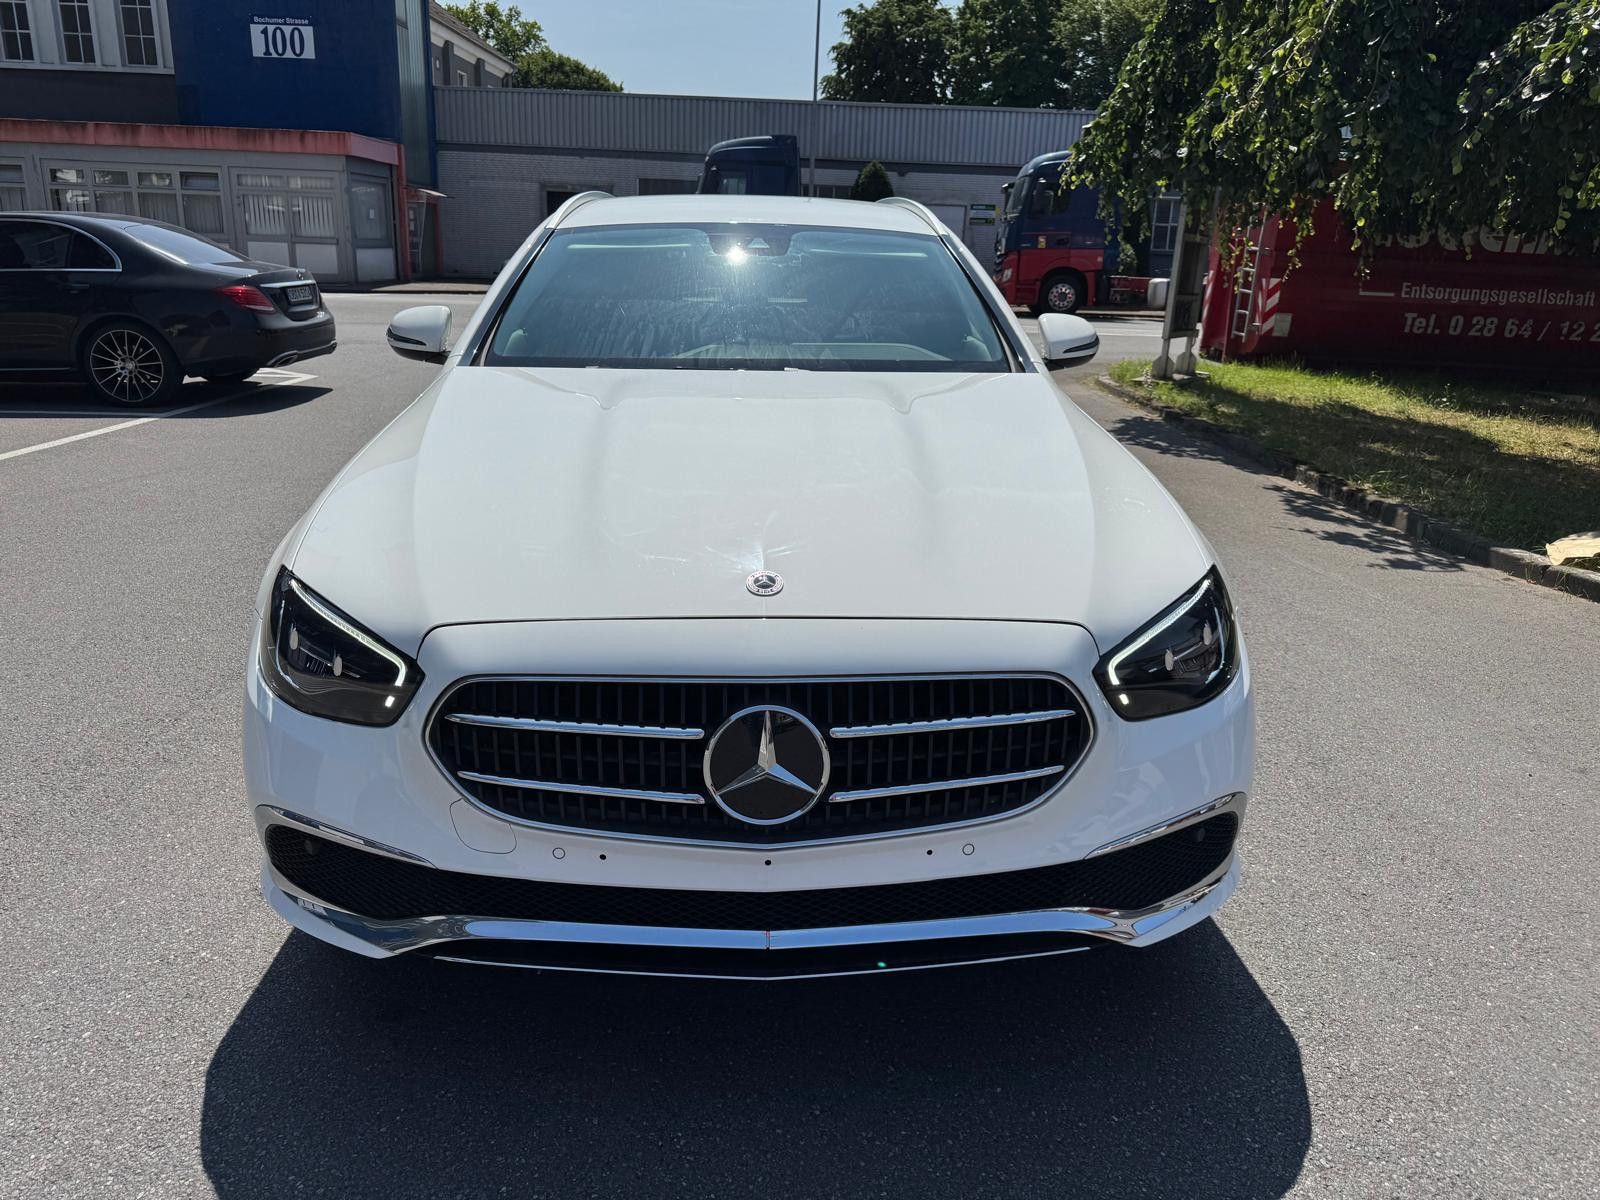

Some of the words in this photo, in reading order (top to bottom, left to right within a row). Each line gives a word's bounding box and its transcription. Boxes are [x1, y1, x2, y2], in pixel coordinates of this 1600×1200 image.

[260, 26, 305, 57] 100
[1401, 282, 1596, 306] Entsorgungsgesellschaft
[1403, 312, 1440, 335] Tel.
[1448, 315, 1465, 336] 0
[1468, 316, 1499, 337] 28
[1504, 318, 1534, 339] 64
[1559, 321, 1586, 341] 12
